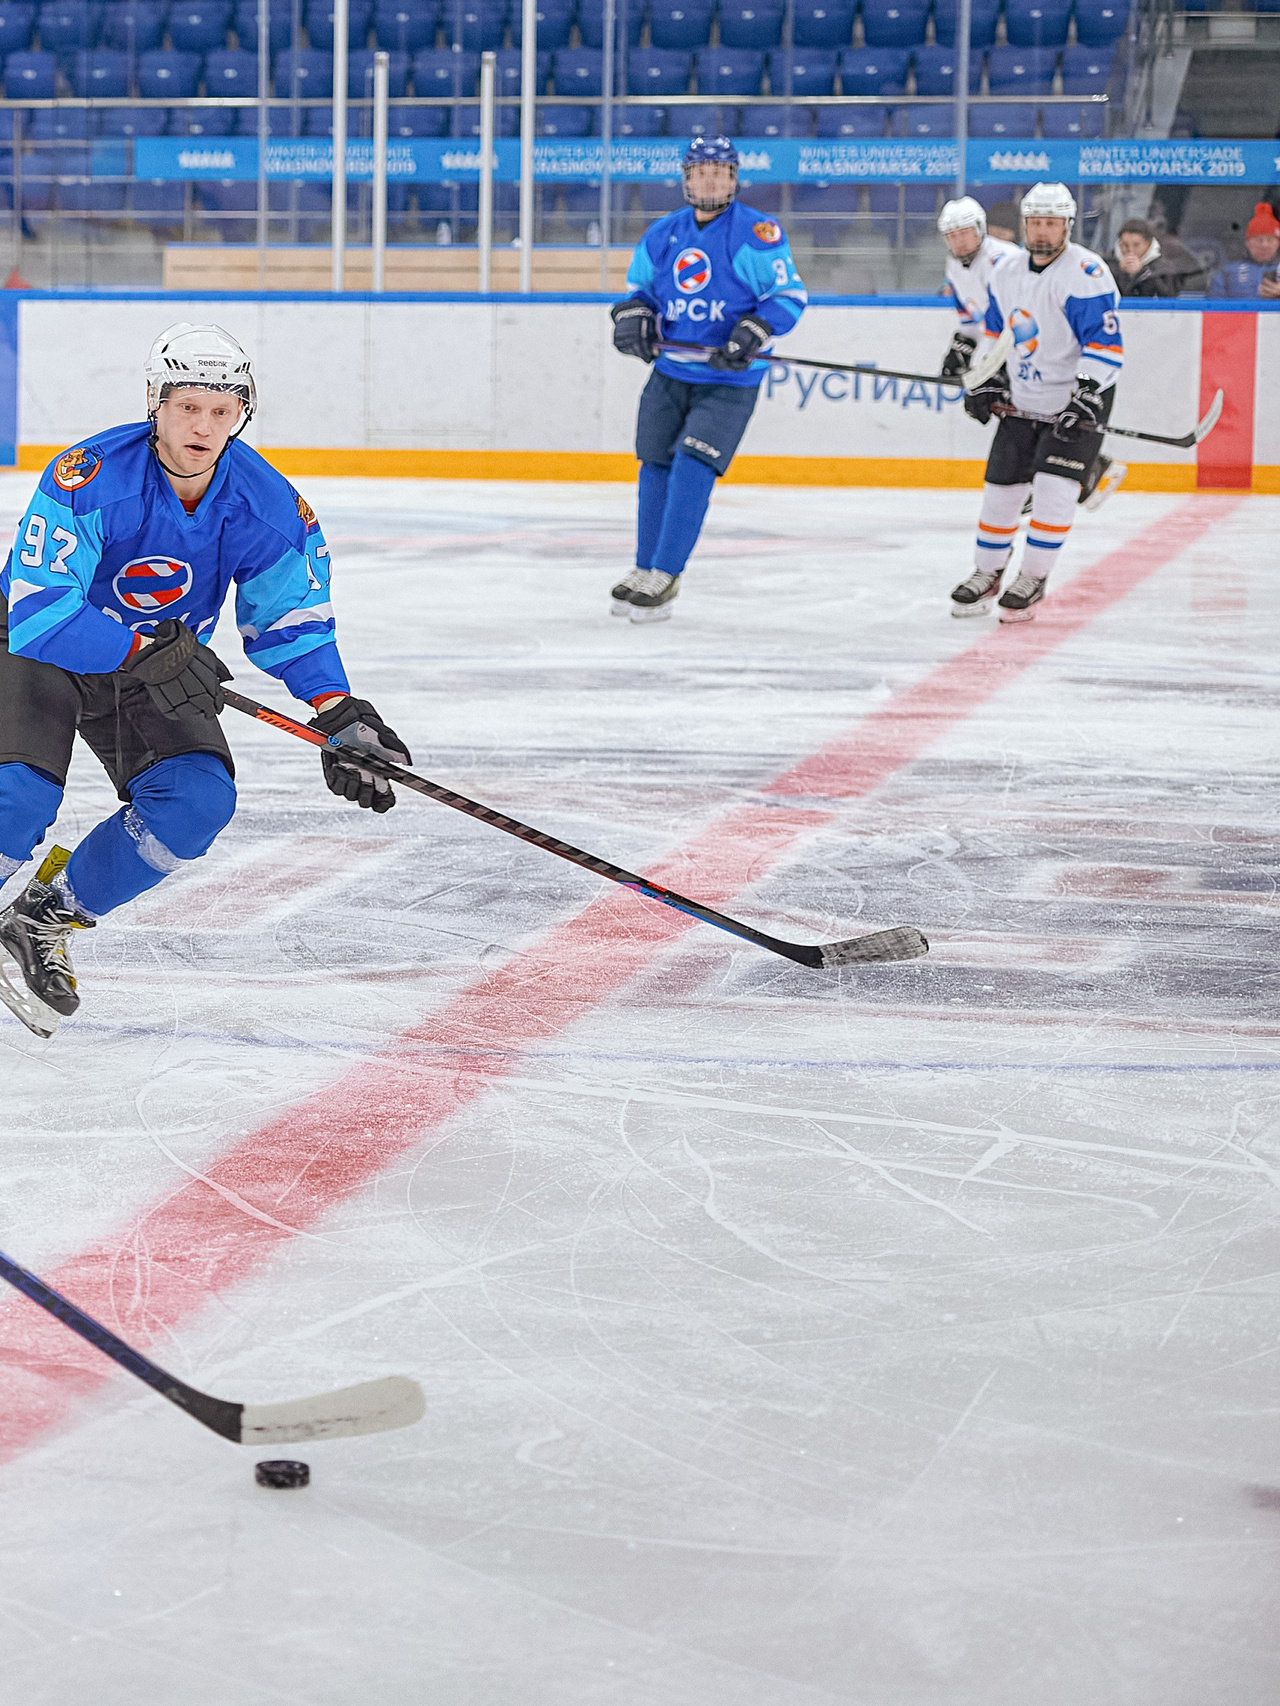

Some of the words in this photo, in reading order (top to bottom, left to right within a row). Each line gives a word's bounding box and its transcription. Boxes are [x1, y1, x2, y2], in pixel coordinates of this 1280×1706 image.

[800, 145, 858, 158] WINTER
[1079, 146, 1139, 160] WINTER
[1144, 146, 1243, 161] UNIVERSIADE
[798, 160, 922, 176] KRASNOYARSK
[925, 160, 961, 176] 2019
[1078, 161, 1205, 177] KRASNOYARSK
[1207, 161, 1246, 177] 2019
[198, 360, 228, 368] Reebok
[766, 361, 966, 413] РусГидр
[19, 513, 78, 575] 97
